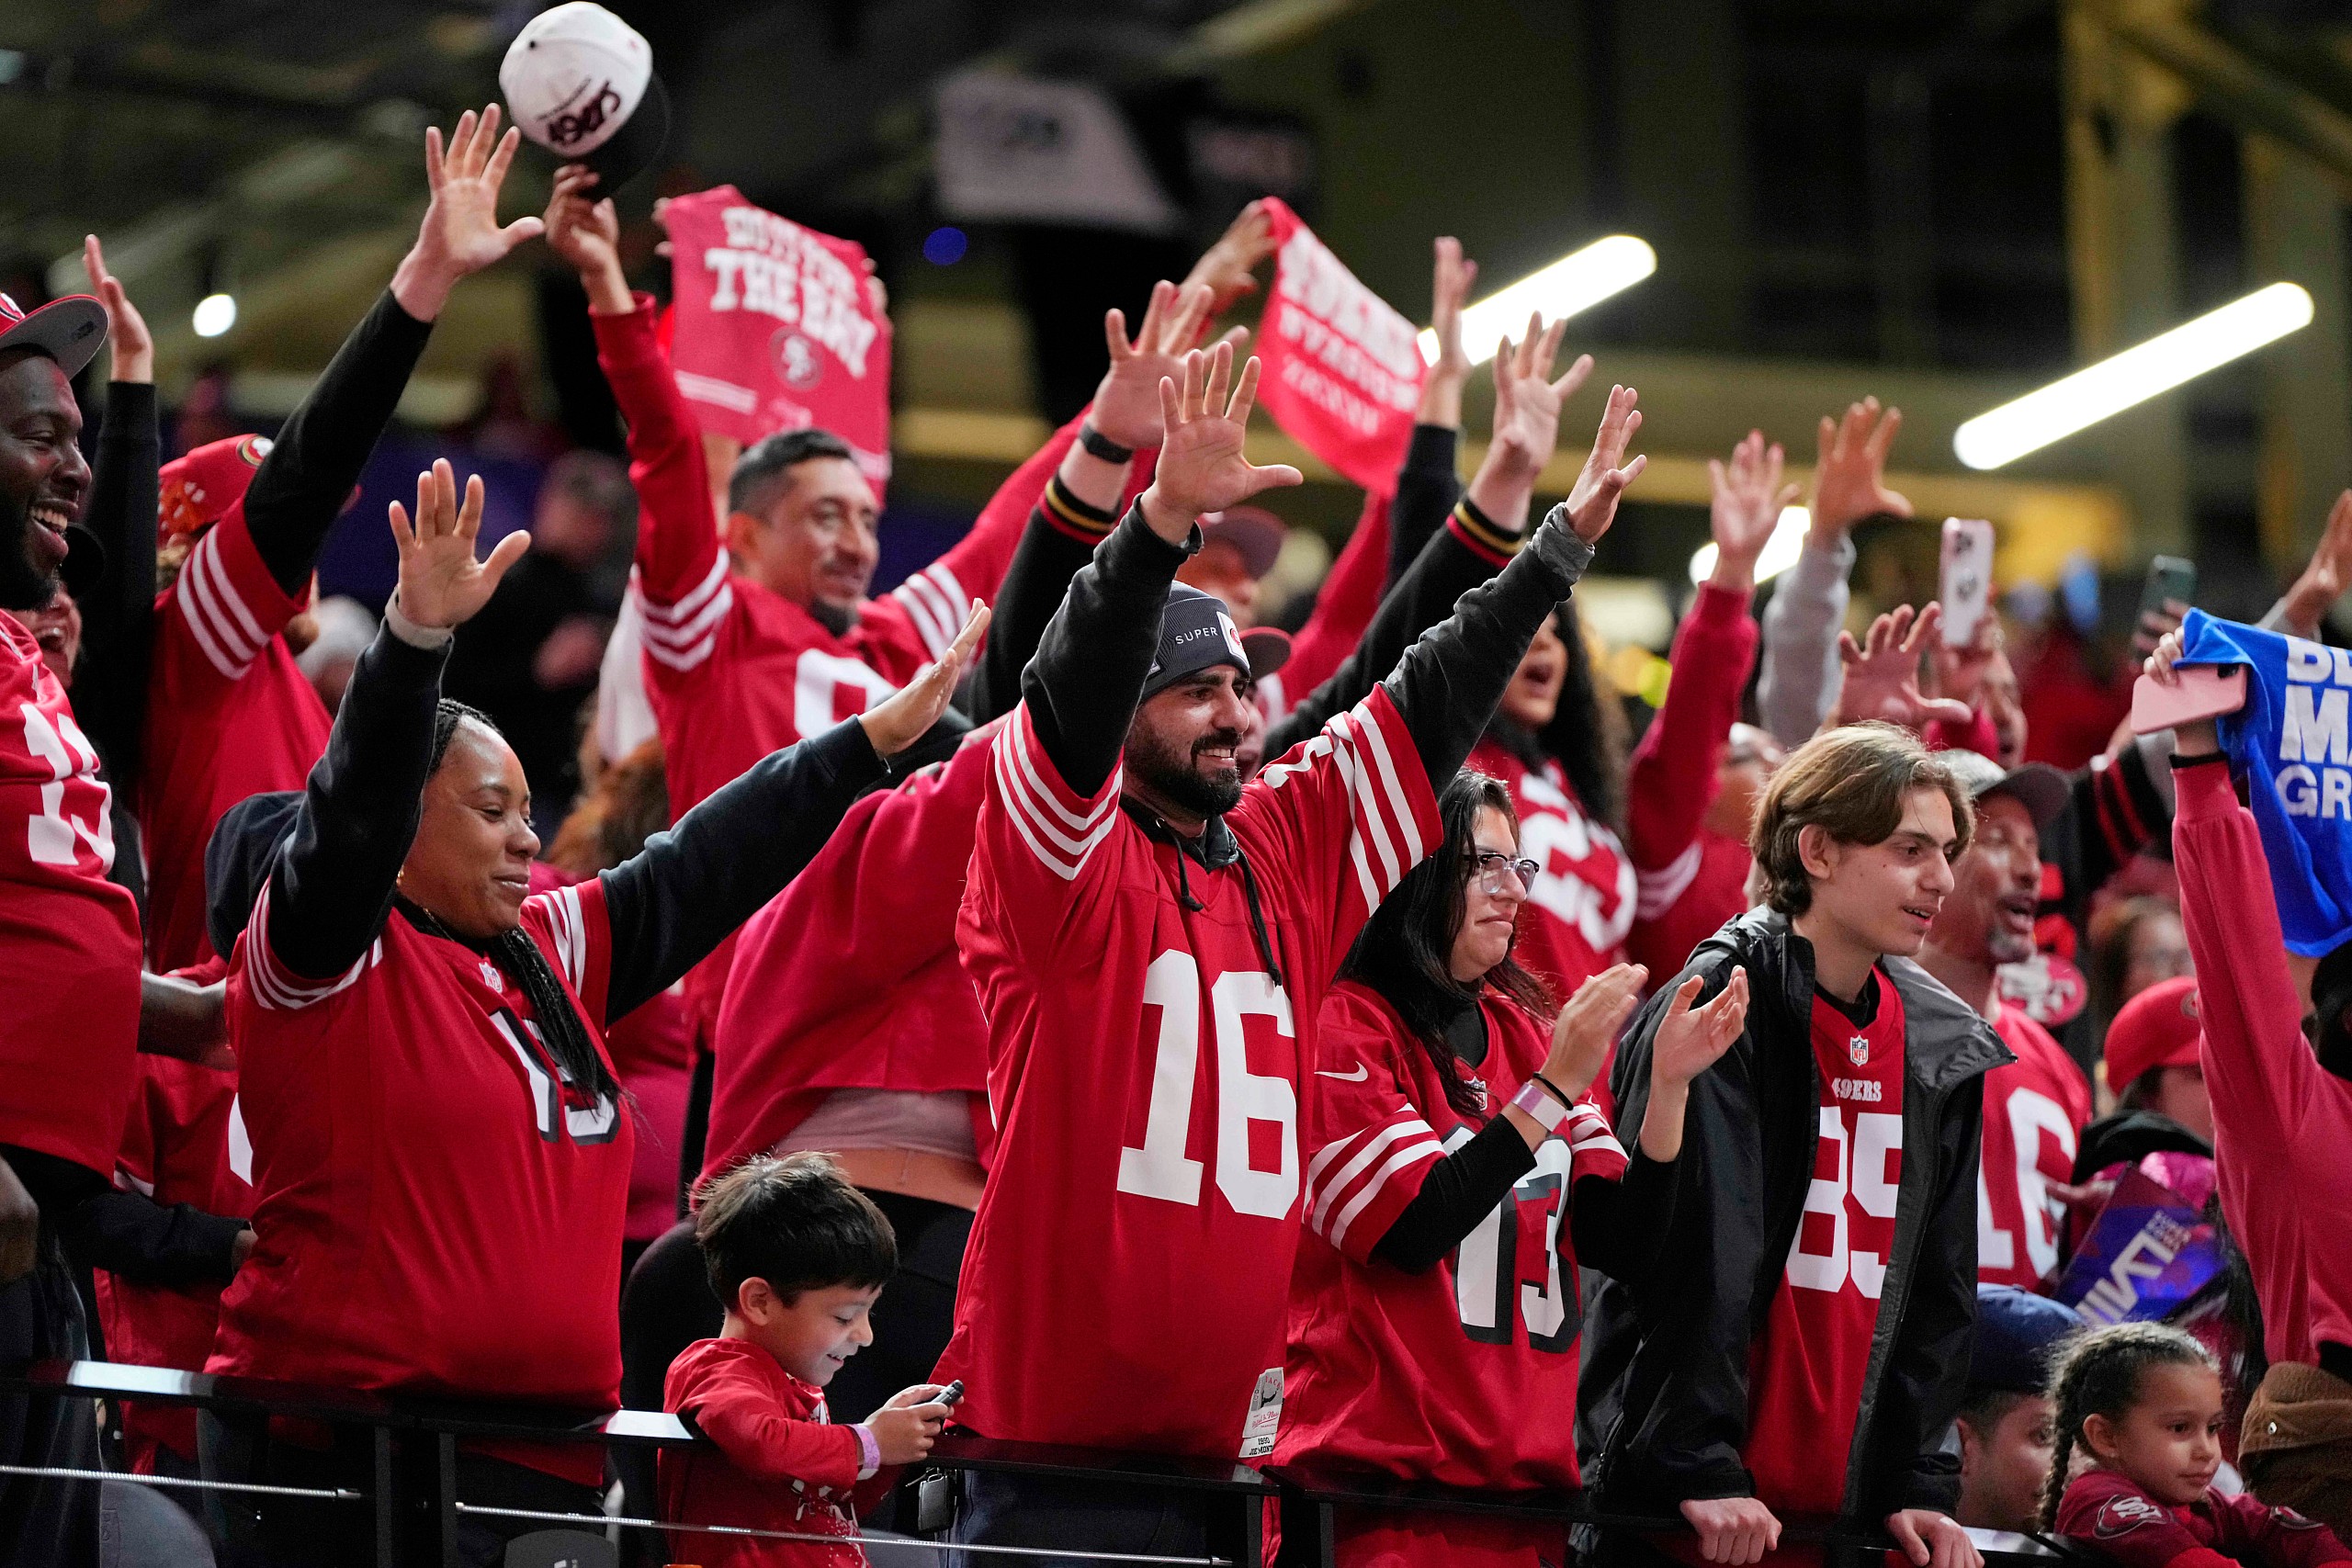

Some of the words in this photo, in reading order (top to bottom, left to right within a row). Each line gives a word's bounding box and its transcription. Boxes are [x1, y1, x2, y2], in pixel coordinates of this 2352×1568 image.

[704, 247, 800, 323] THE
[1175, 626, 1218, 645] SUPER
[2279, 684, 2352, 767] M
[2275, 763, 2352, 820] GR
[1116, 949, 1300, 1220] 16
[1785, 1105, 1903, 1300] 85
